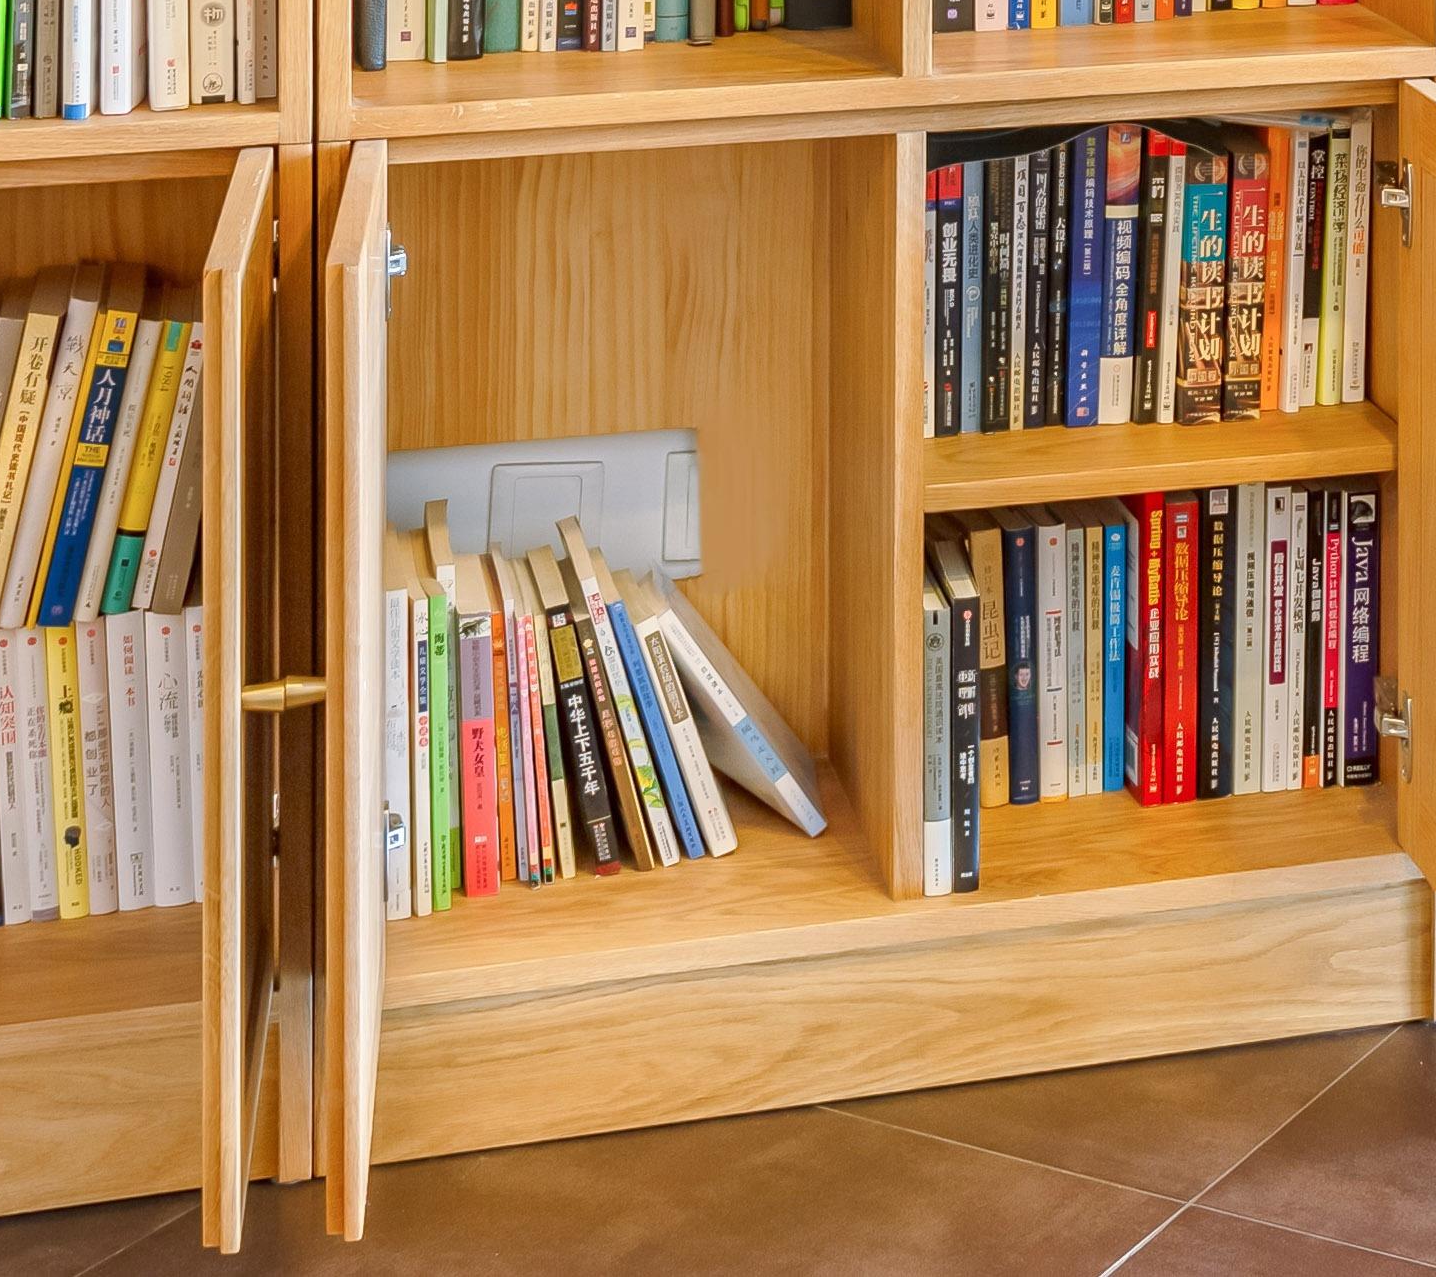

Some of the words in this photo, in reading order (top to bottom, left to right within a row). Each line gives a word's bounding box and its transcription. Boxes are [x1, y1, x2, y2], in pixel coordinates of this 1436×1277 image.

[18, 336, 47, 406] 开卷有疑
[83, 369, 116, 442] 人月神话
[1173, 541, 1190, 620] 数据压缩导论
[1352, 537, 1373, 663] Java网络编程
[982, 595, 1001, 660] 昆虫记
[0, 686, 17, 745] 认知突围
[567, 694, 600, 796] 中华上下五千年
[74, 846, 83, 886] HOOKED
